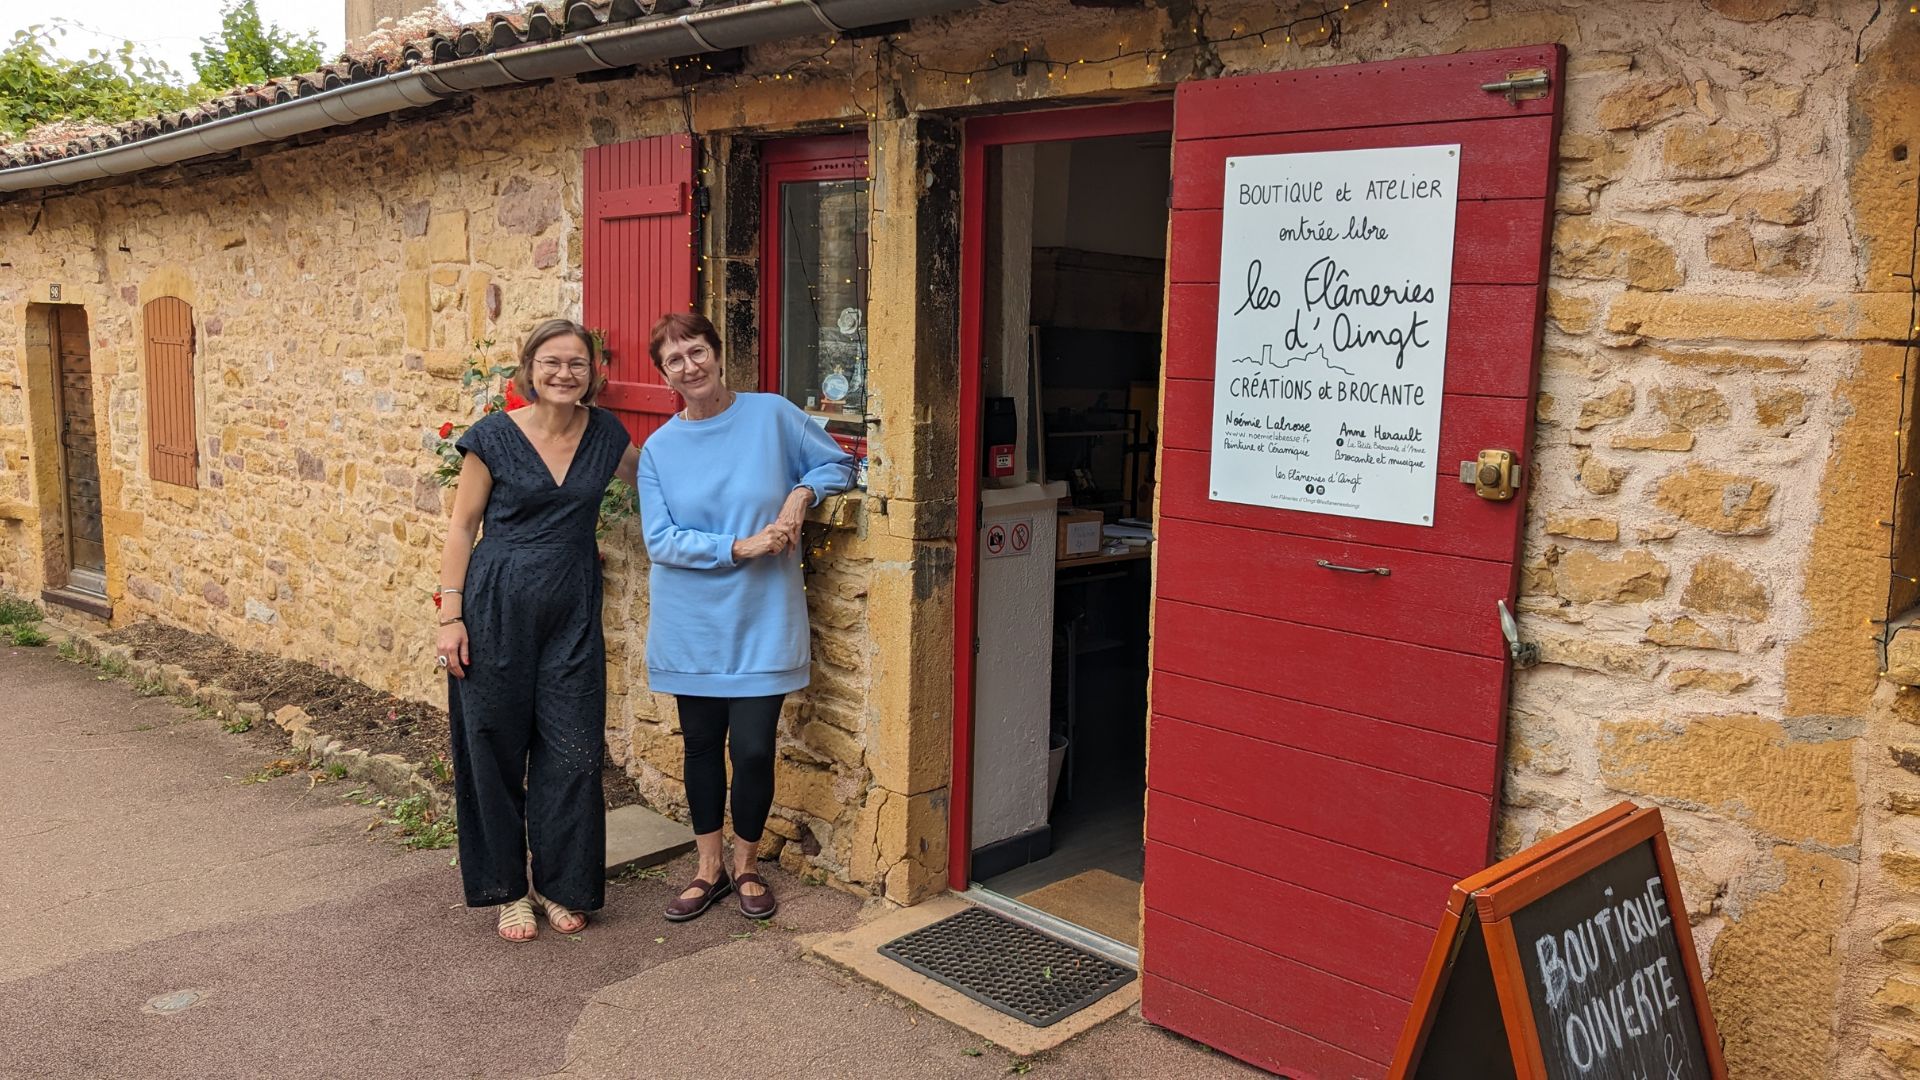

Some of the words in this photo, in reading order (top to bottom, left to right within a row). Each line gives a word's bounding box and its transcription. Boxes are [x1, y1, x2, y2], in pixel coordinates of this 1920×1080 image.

[1336, 182, 1352, 202] et
[1279, 216, 1340, 241] entrée
[1342, 216, 1389, 241] libre
[50, 286, 59, 298] 98
[1234, 259, 1281, 316] les
[1304, 256, 1434, 312] Flâneries
[1318, 381, 1333, 400] et
[1225, 410, 1262, 429] Noémie
[1266, 415, 1312, 432] Labrosse
[1339, 421, 1366, 438] Anne
[1374, 424, 1423, 441] Herault
[1223, 437, 1255, 452] Peinture
[1257, 442, 1265, 452] et
[1268, 442, 1310, 461] Céramique
[1334, 449, 1375, 465] Brocante
[1376, 452, 1386, 464] et
[1387, 458, 1425, 474] musique
[1288, 469, 1325, 483] Flâneries
[1535, 876, 1671, 1009] BOUTIQUE
[1566, 956, 1680, 1074] OUVERTE
